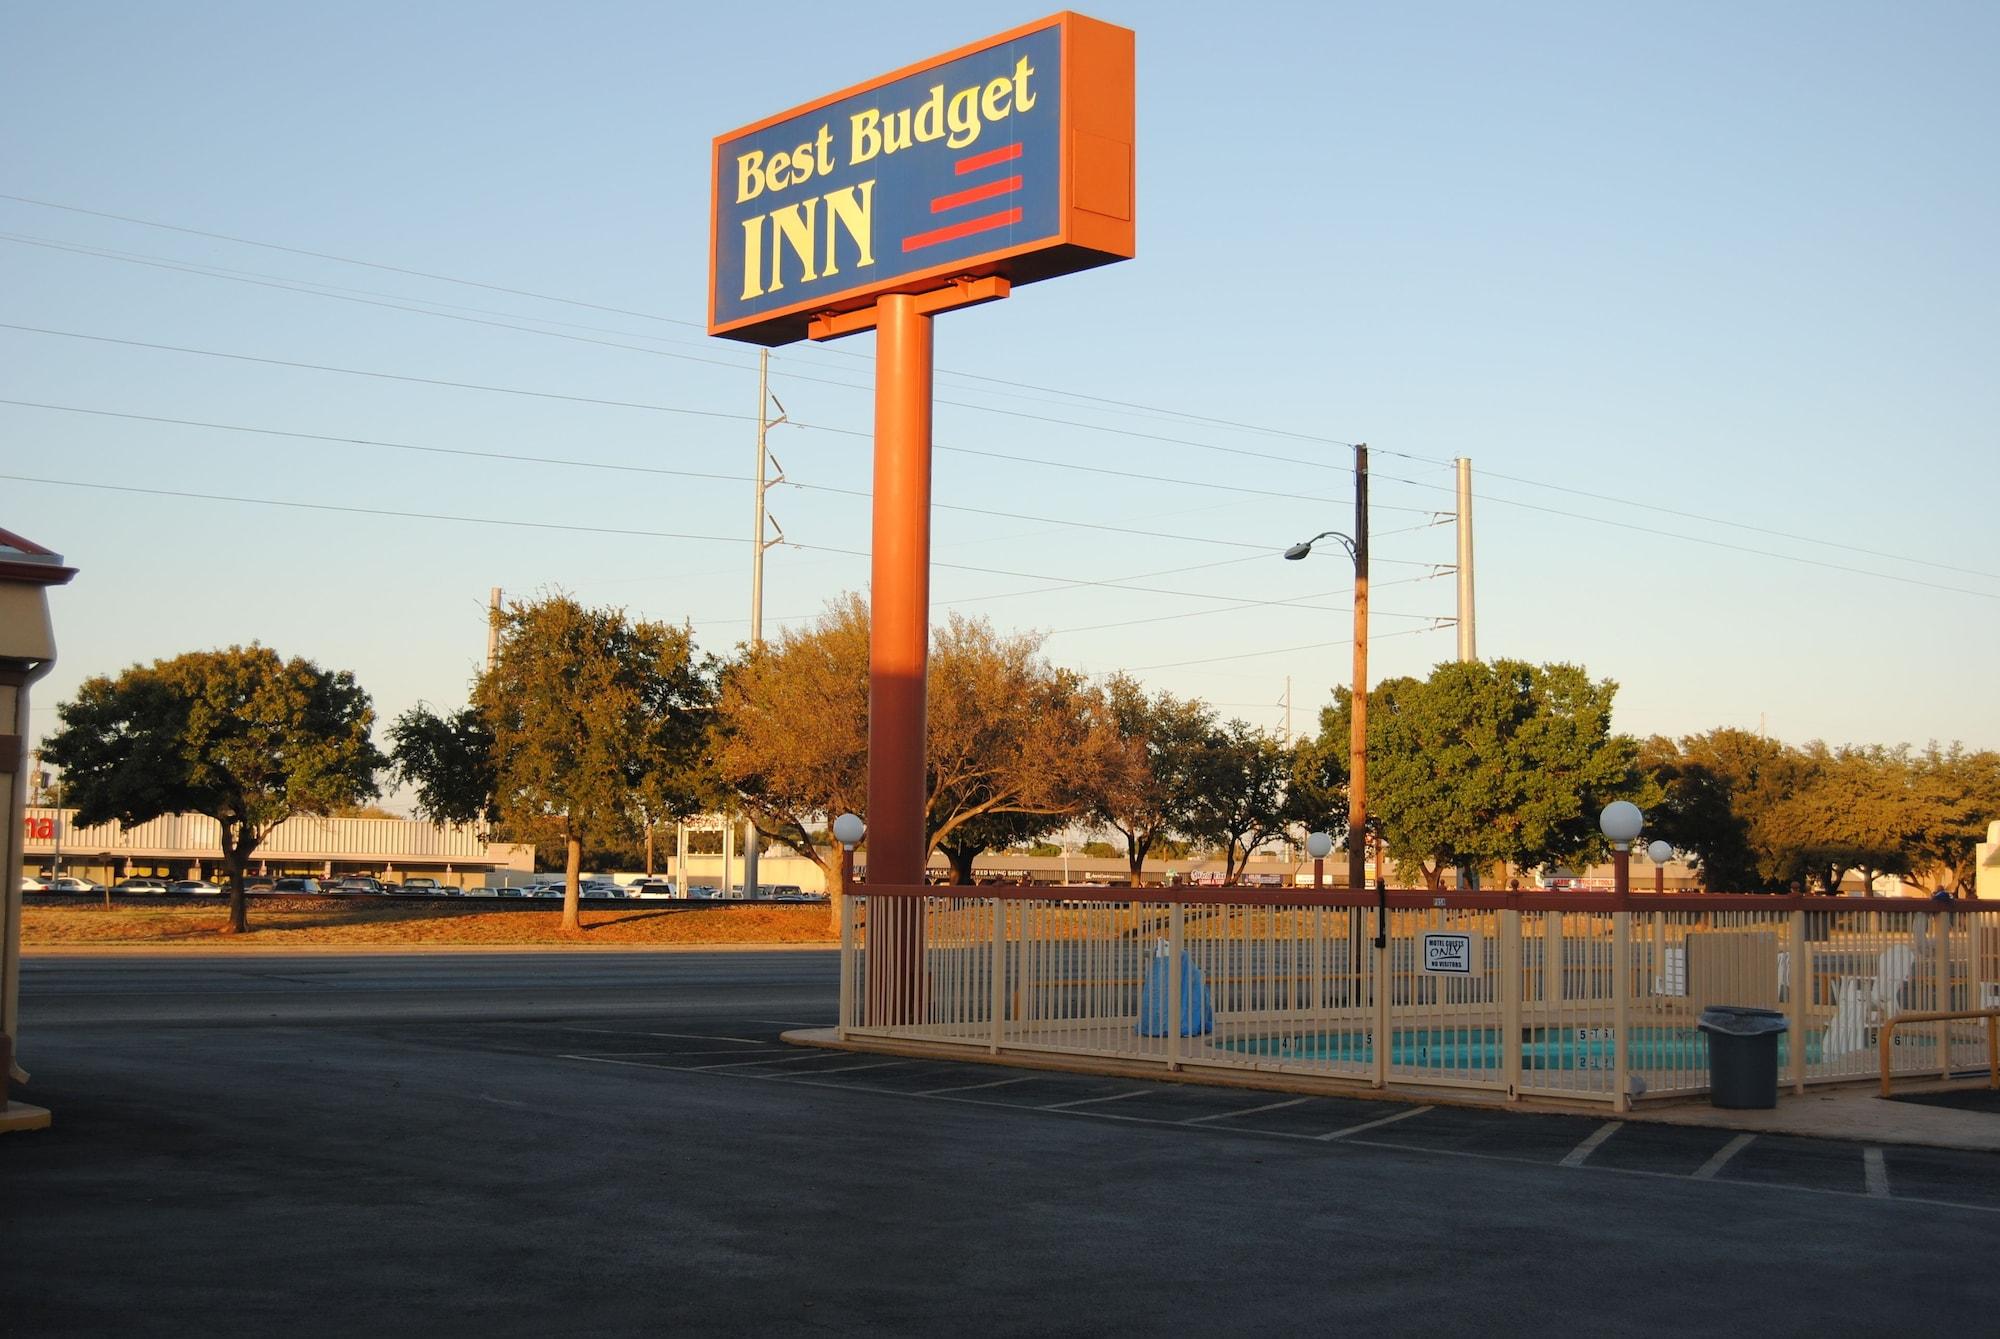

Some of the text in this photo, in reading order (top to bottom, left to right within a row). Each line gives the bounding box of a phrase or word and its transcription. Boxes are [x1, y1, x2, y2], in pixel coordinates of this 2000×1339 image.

[736, 55, 1037, 204] Best Budget
[740, 180, 876, 301] INN
[1430, 944, 1463, 957] ONLY
